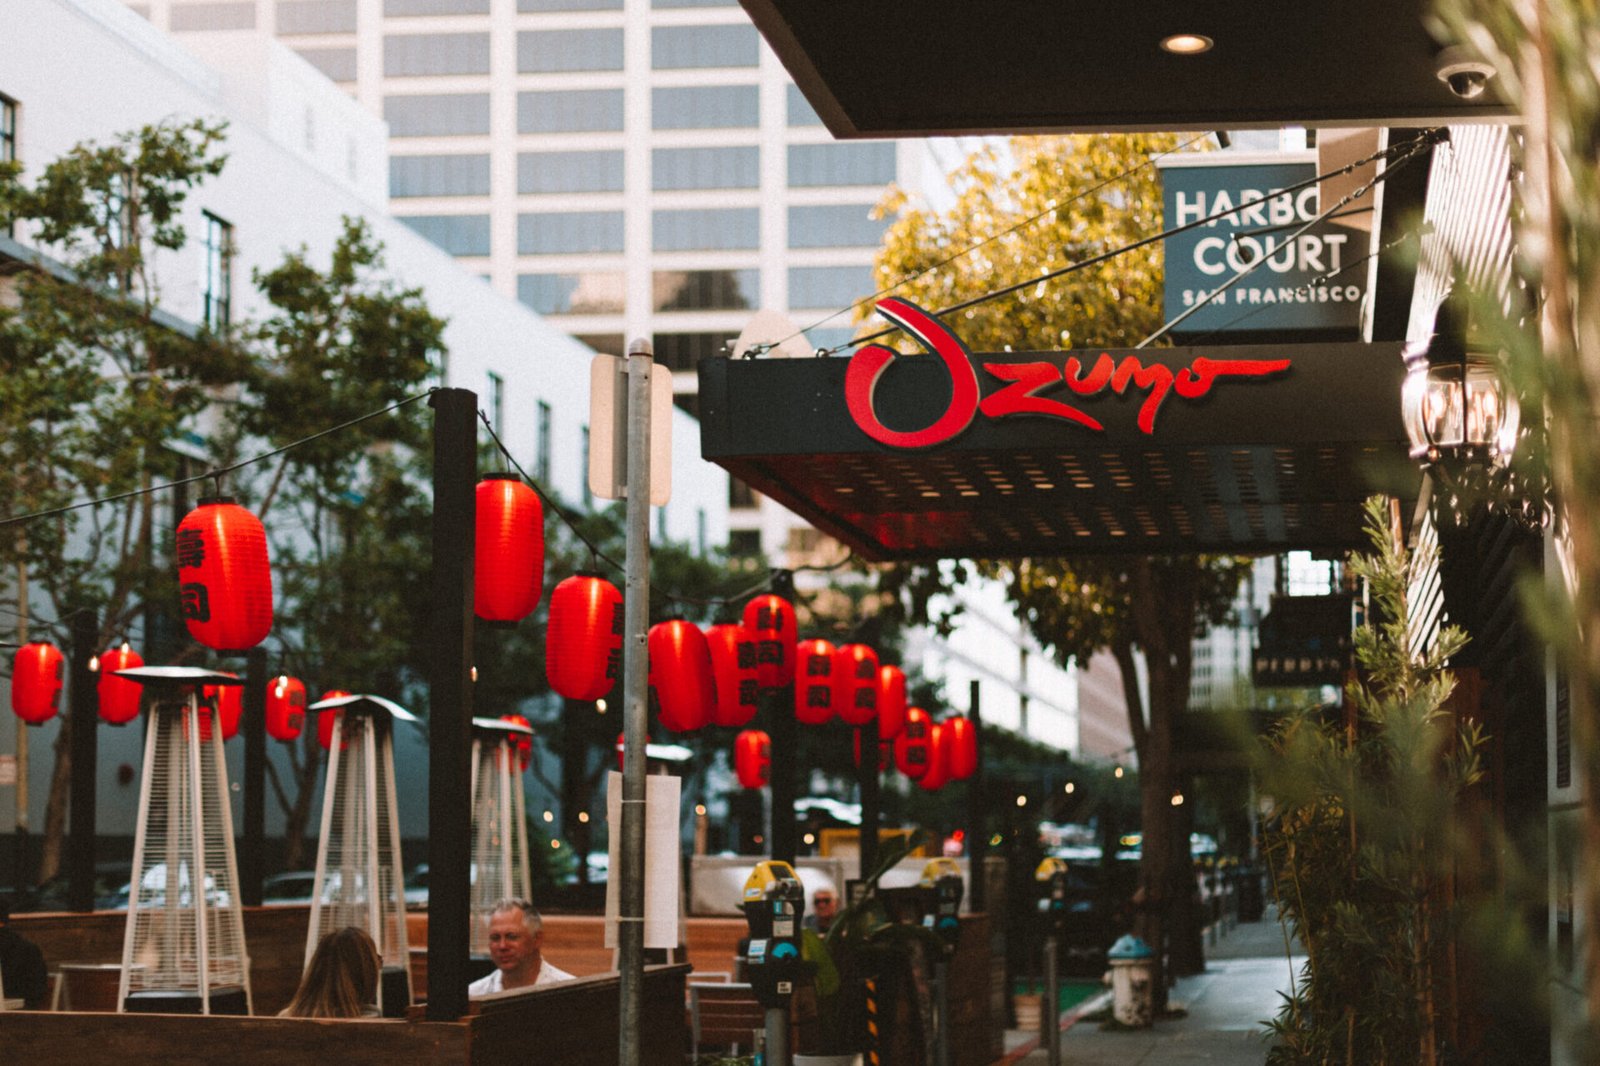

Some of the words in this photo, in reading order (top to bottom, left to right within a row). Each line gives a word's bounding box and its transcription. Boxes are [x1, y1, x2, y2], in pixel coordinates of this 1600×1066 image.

[1175, 187, 1320, 227] HARBO
[1193, 233, 1347, 275] COURT
[1182, 289, 1226, 306] SAN
[1236, 284, 1360, 304] FRANCISCO
